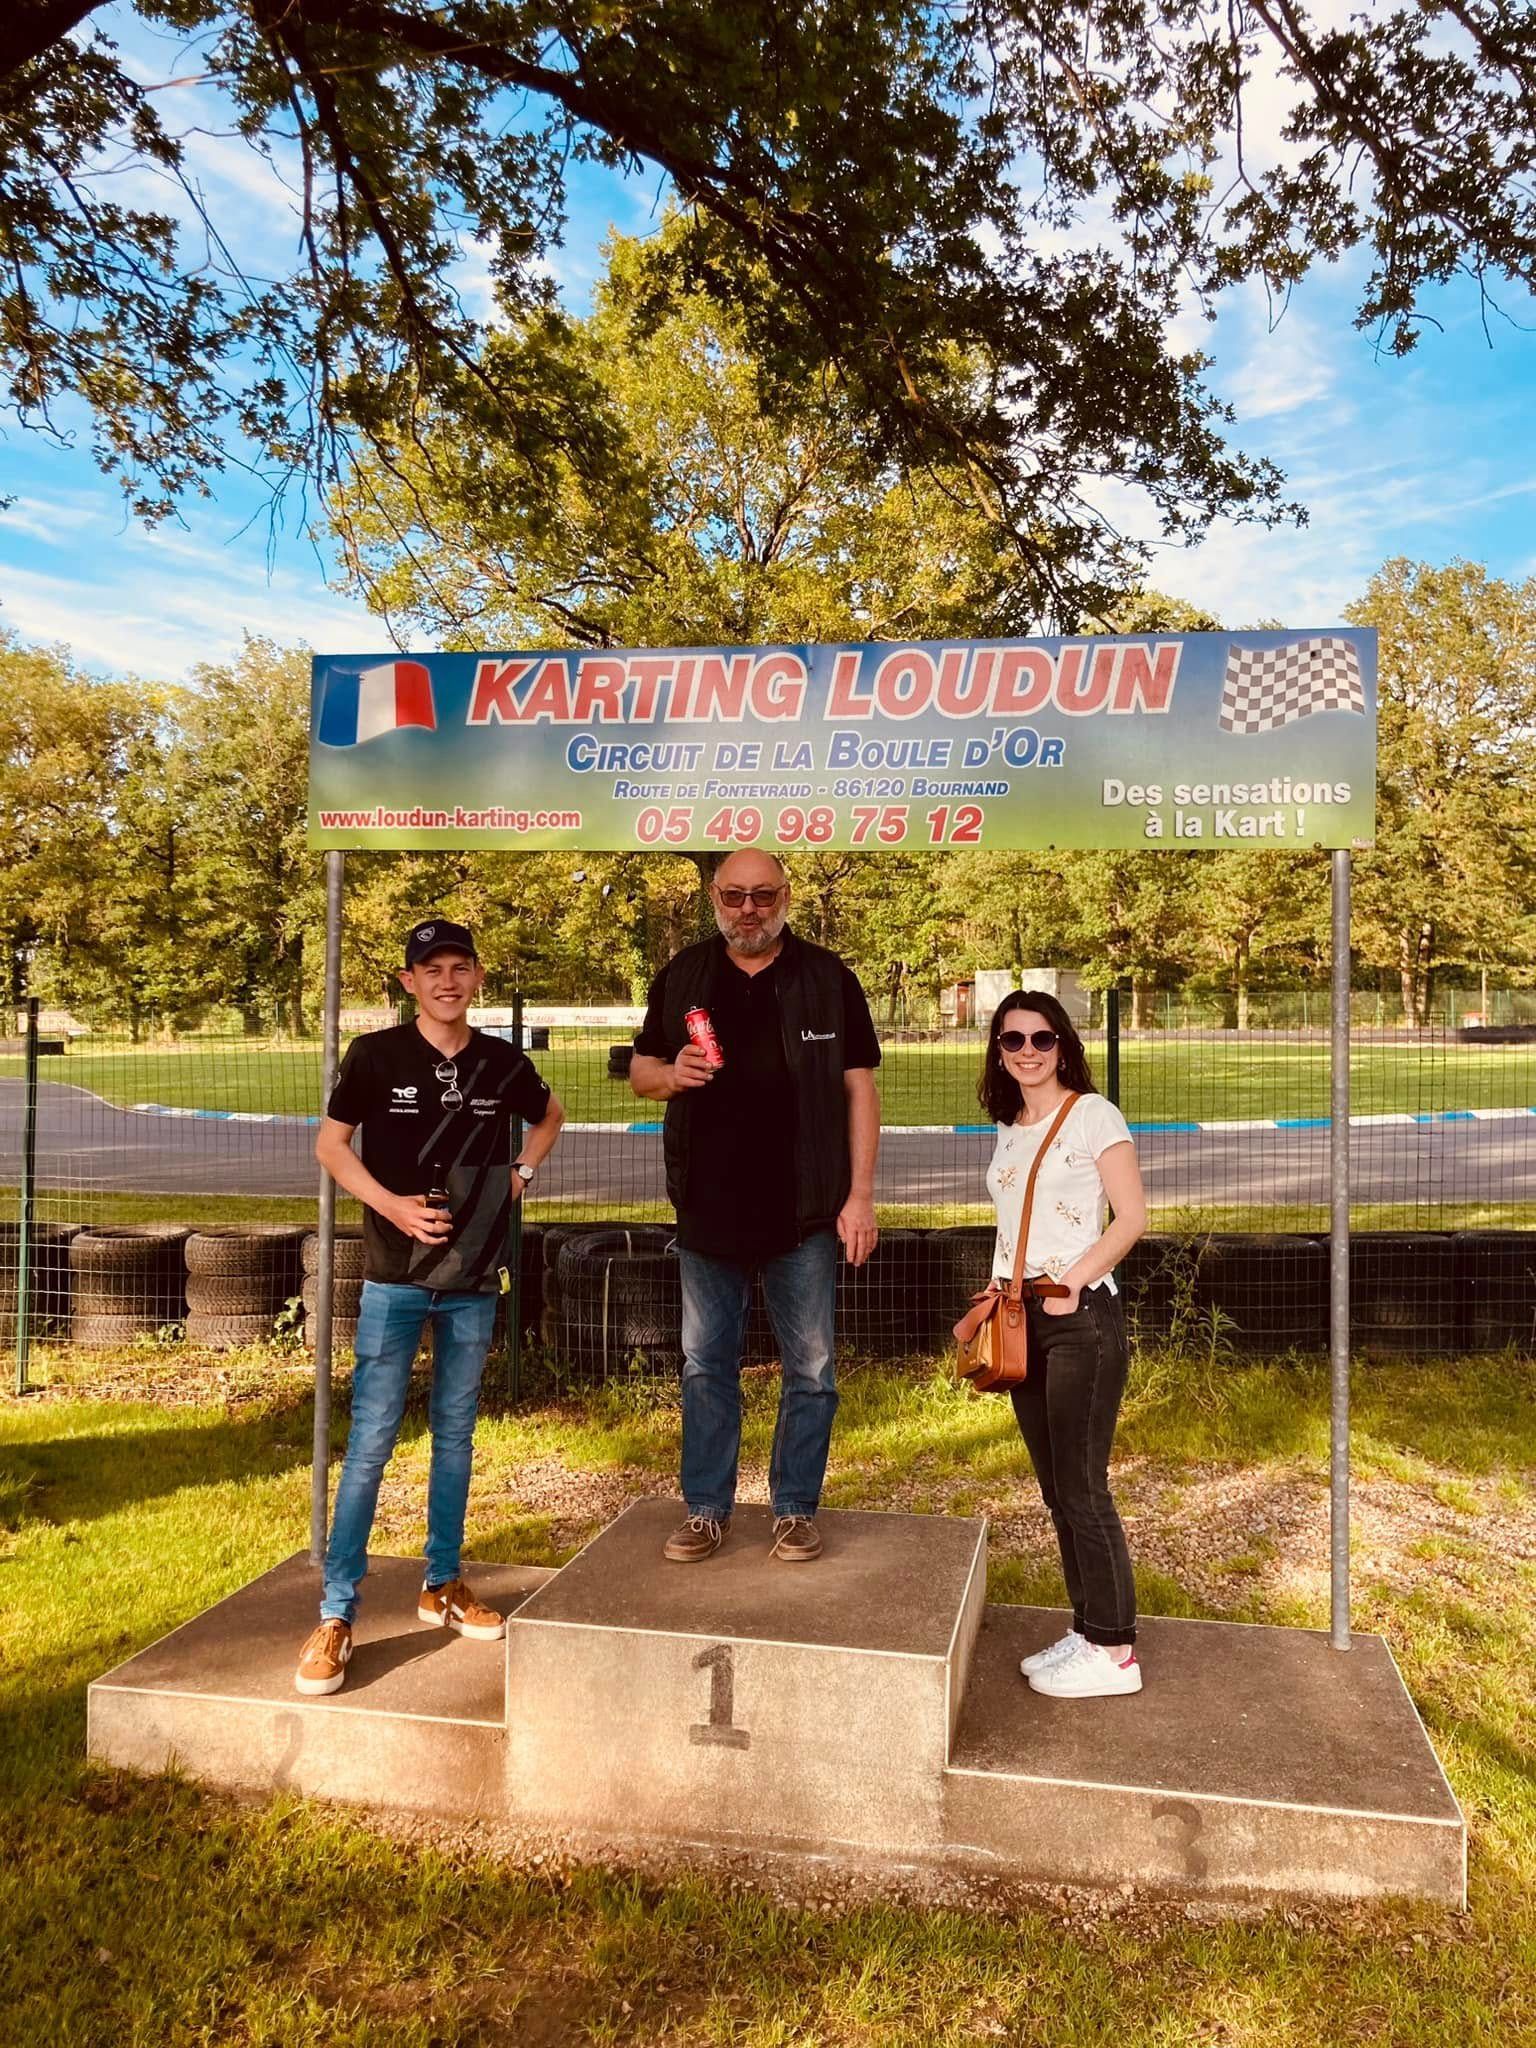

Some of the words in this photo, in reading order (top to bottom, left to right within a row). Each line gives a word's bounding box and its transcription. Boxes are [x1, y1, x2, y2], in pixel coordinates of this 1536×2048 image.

[466, 654, 808, 726] KARTING
[823, 642, 1184, 721] LOUDUN
[833, 777, 905, 798] 86120
[1102, 778, 1164, 806] Des
[1173, 776, 1352, 804] sensations
[319, 806, 582, 832] www.loudun-karting.com
[636, 805, 694, 844] 05
[703, 805, 763, 844] 49
[775, 805, 836, 844] 98
[850, 804, 910, 845] 75
[926, 803, 984, 844] 12
[1144, 810, 1163, 838] à
[1175, 810, 1202, 837] la
[1214, 809, 1287, 837] Kart
[1295, 809, 1305, 836] !
[689, 1644, 751, 1751] 1
